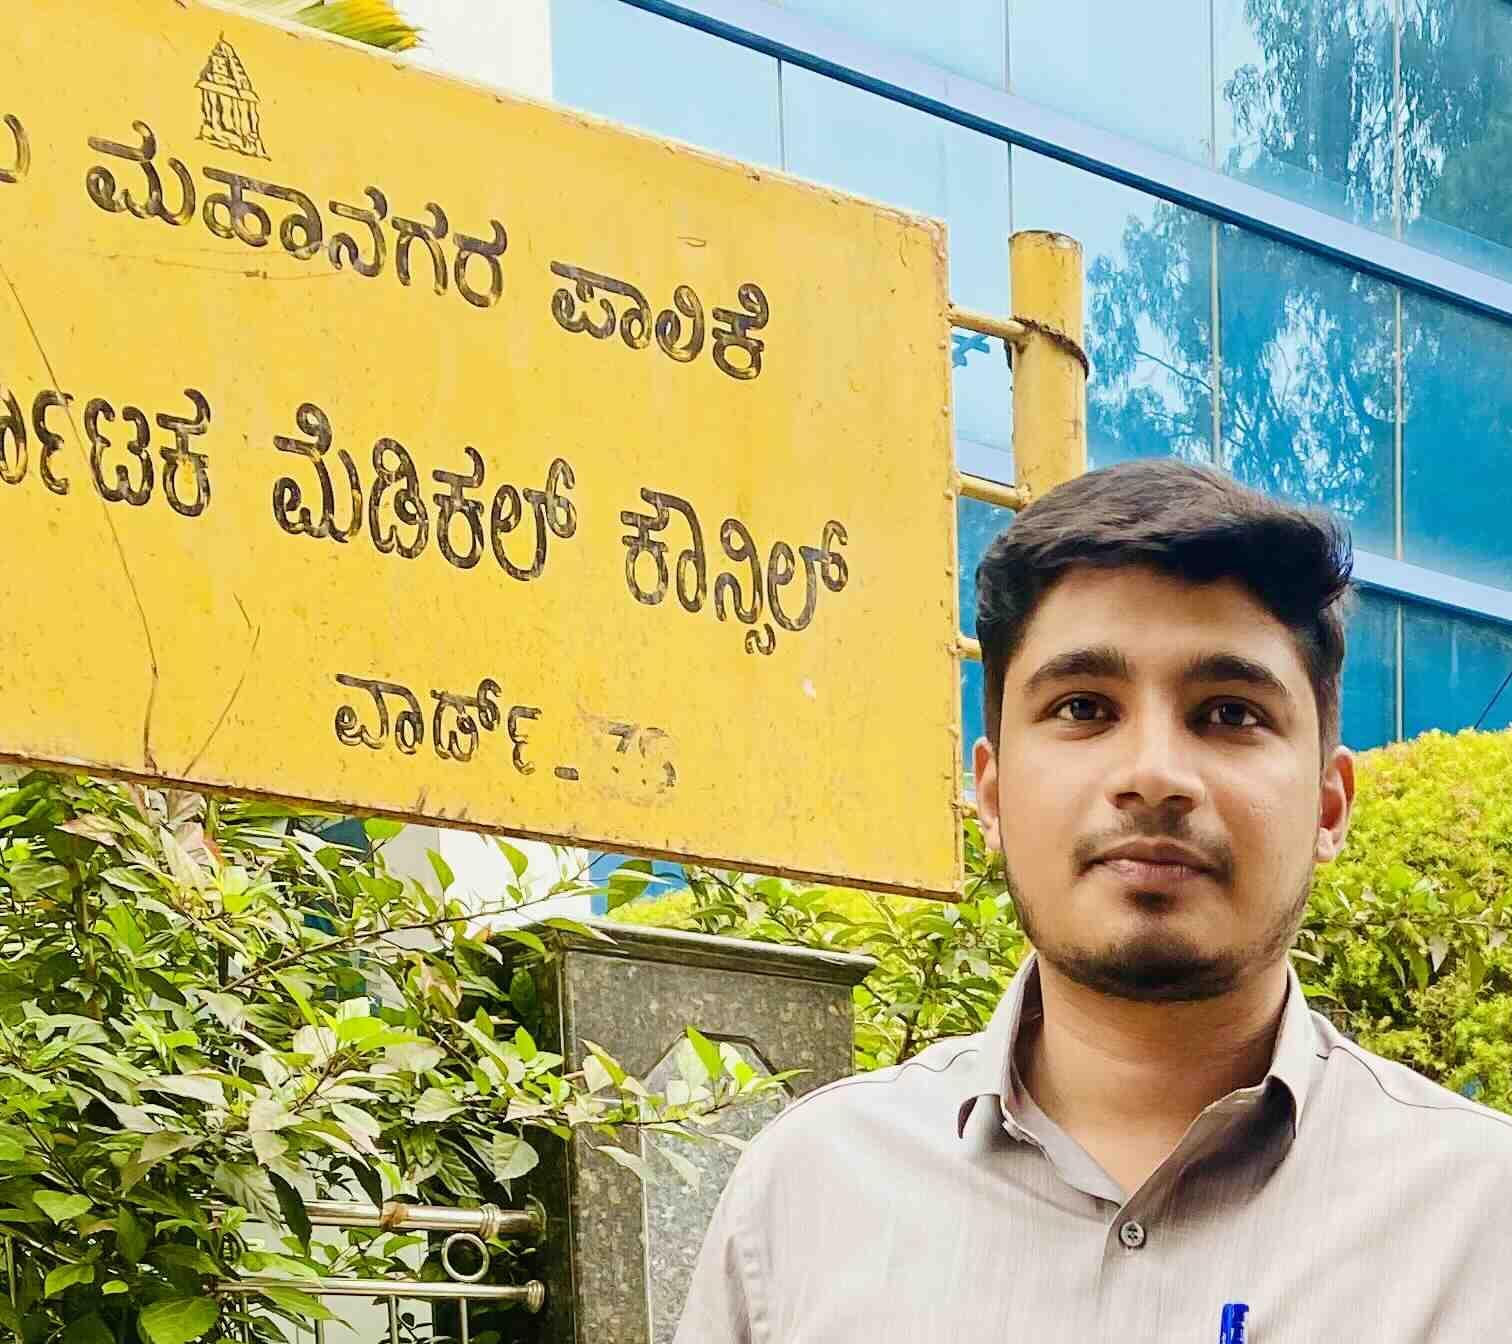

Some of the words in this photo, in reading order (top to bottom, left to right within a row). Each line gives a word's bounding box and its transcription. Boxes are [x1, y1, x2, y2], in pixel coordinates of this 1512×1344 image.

[86, 120, 508, 308] ಮಹಾನಗರ
[550, 260, 769, 380] ಪಾಲಿಕೆ
[273, 402, 577, 582] ಮೆಡಿಕಲ್
[621, 488, 849, 656] ಕೌನ್ಸಿಲ್
